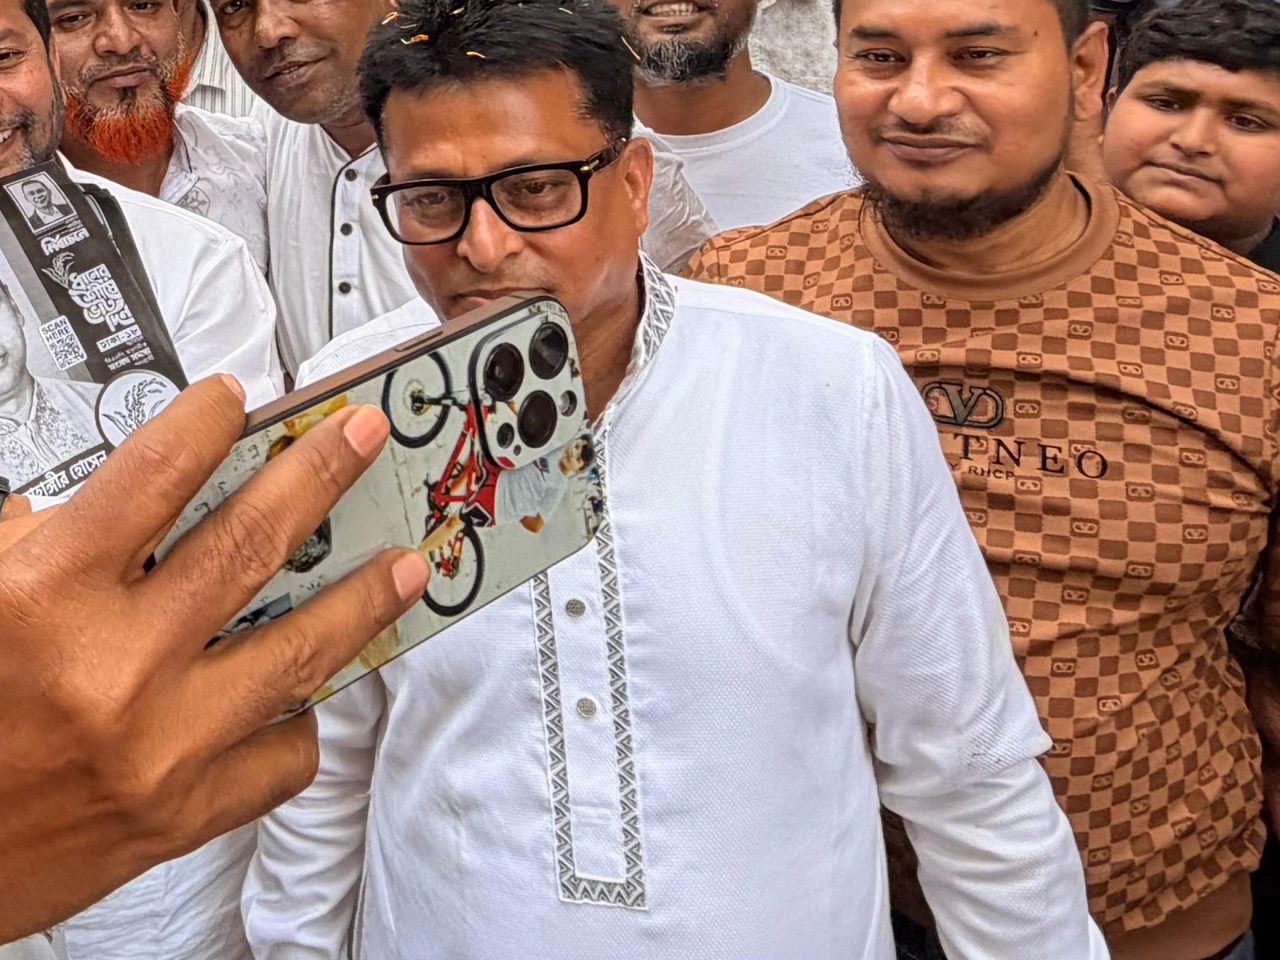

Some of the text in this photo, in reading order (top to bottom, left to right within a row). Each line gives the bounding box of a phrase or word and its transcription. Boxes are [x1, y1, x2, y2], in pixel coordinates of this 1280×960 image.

[40, 227, 90, 256] নির্বাচনে
[69, 264, 112, 291] ধানের
[41, 319, 67, 336] SCAN
[46, 326, 70, 342] HERE
[953, 433, 1108, 480] TNEO
[23, 470, 69, 496] হাঙ্গীর
[968, 464, 1015, 481] RHCP
